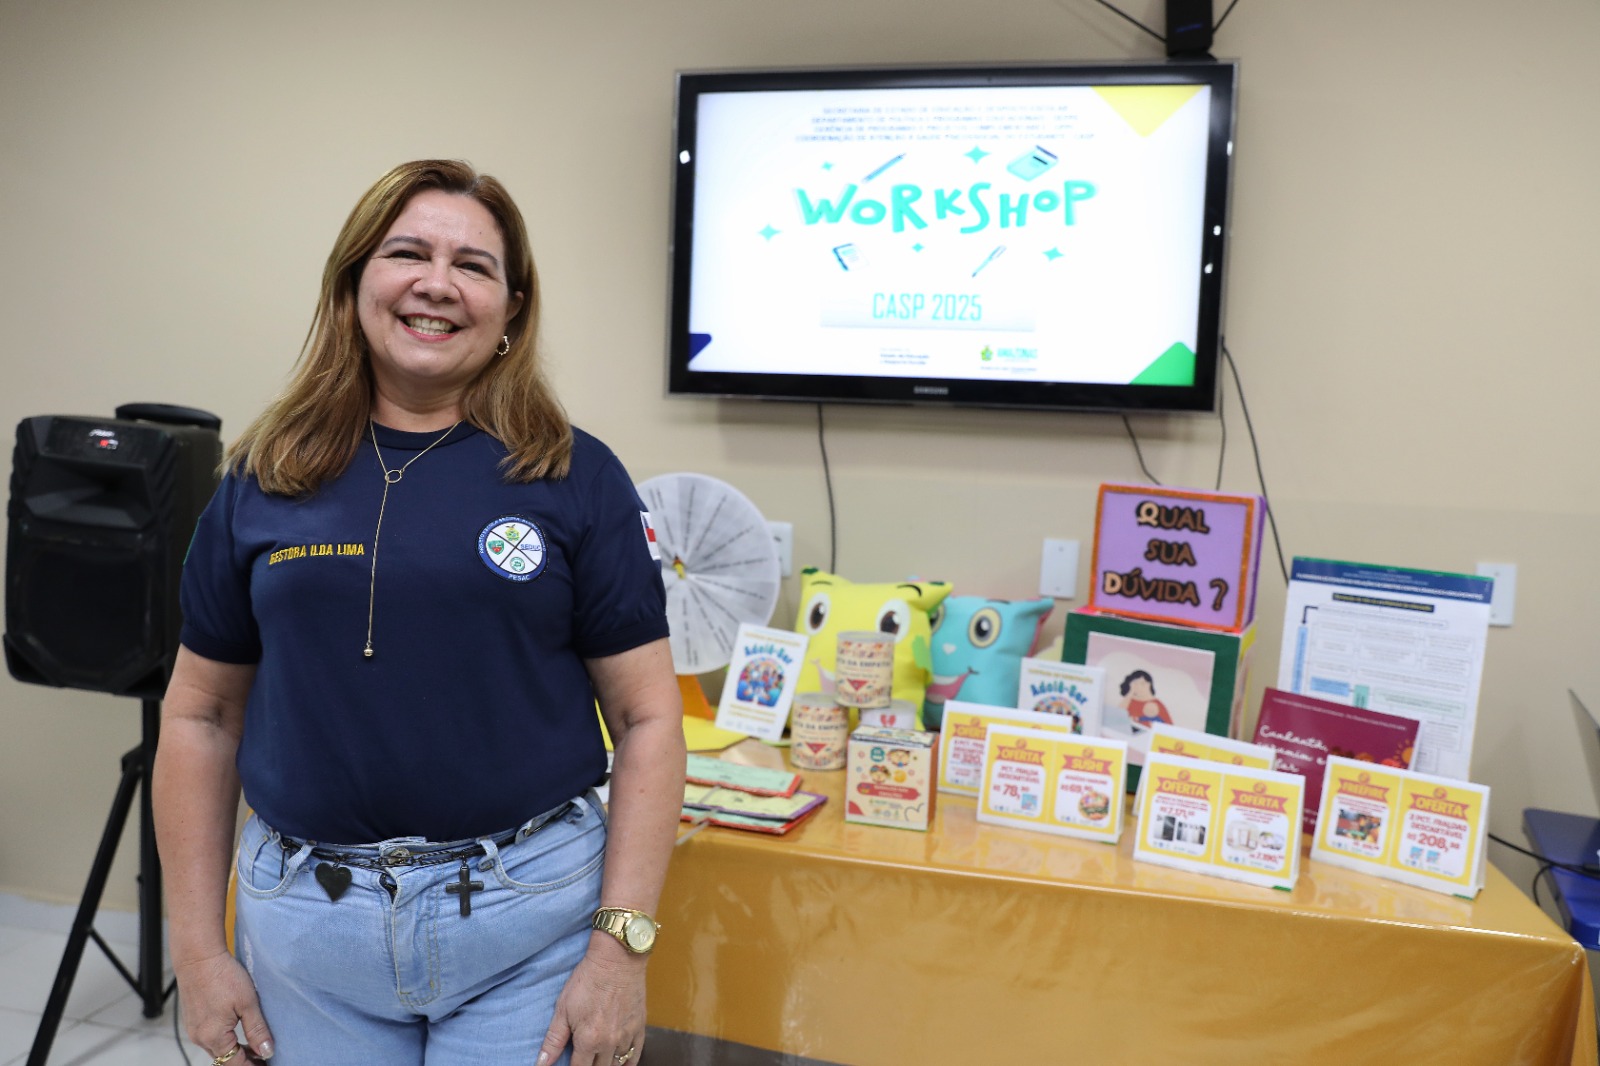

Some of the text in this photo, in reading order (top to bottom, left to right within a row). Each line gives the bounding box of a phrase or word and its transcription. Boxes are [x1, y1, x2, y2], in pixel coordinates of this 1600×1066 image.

[794, 179, 1098, 234] WORKSHOP
[872, 292, 983, 322] CASP 2025
[1135, 500, 1211, 535] QUAL
[268, 543, 365, 566] GESTORA ILDA LIMA
[1143, 538, 1197, 566] SUA
[508, 573, 531, 582] PESAC
[1102, 567, 1230, 612] DÚVIDA ?
[1001, 748, 1041, 763] OFERTA
[1071, 758, 1104, 772] SUSHI
[1162, 780, 1205, 797] OFERTA
[1239, 793, 1280, 809] OFERTA
[1415, 797, 1463, 816] OFERTA
